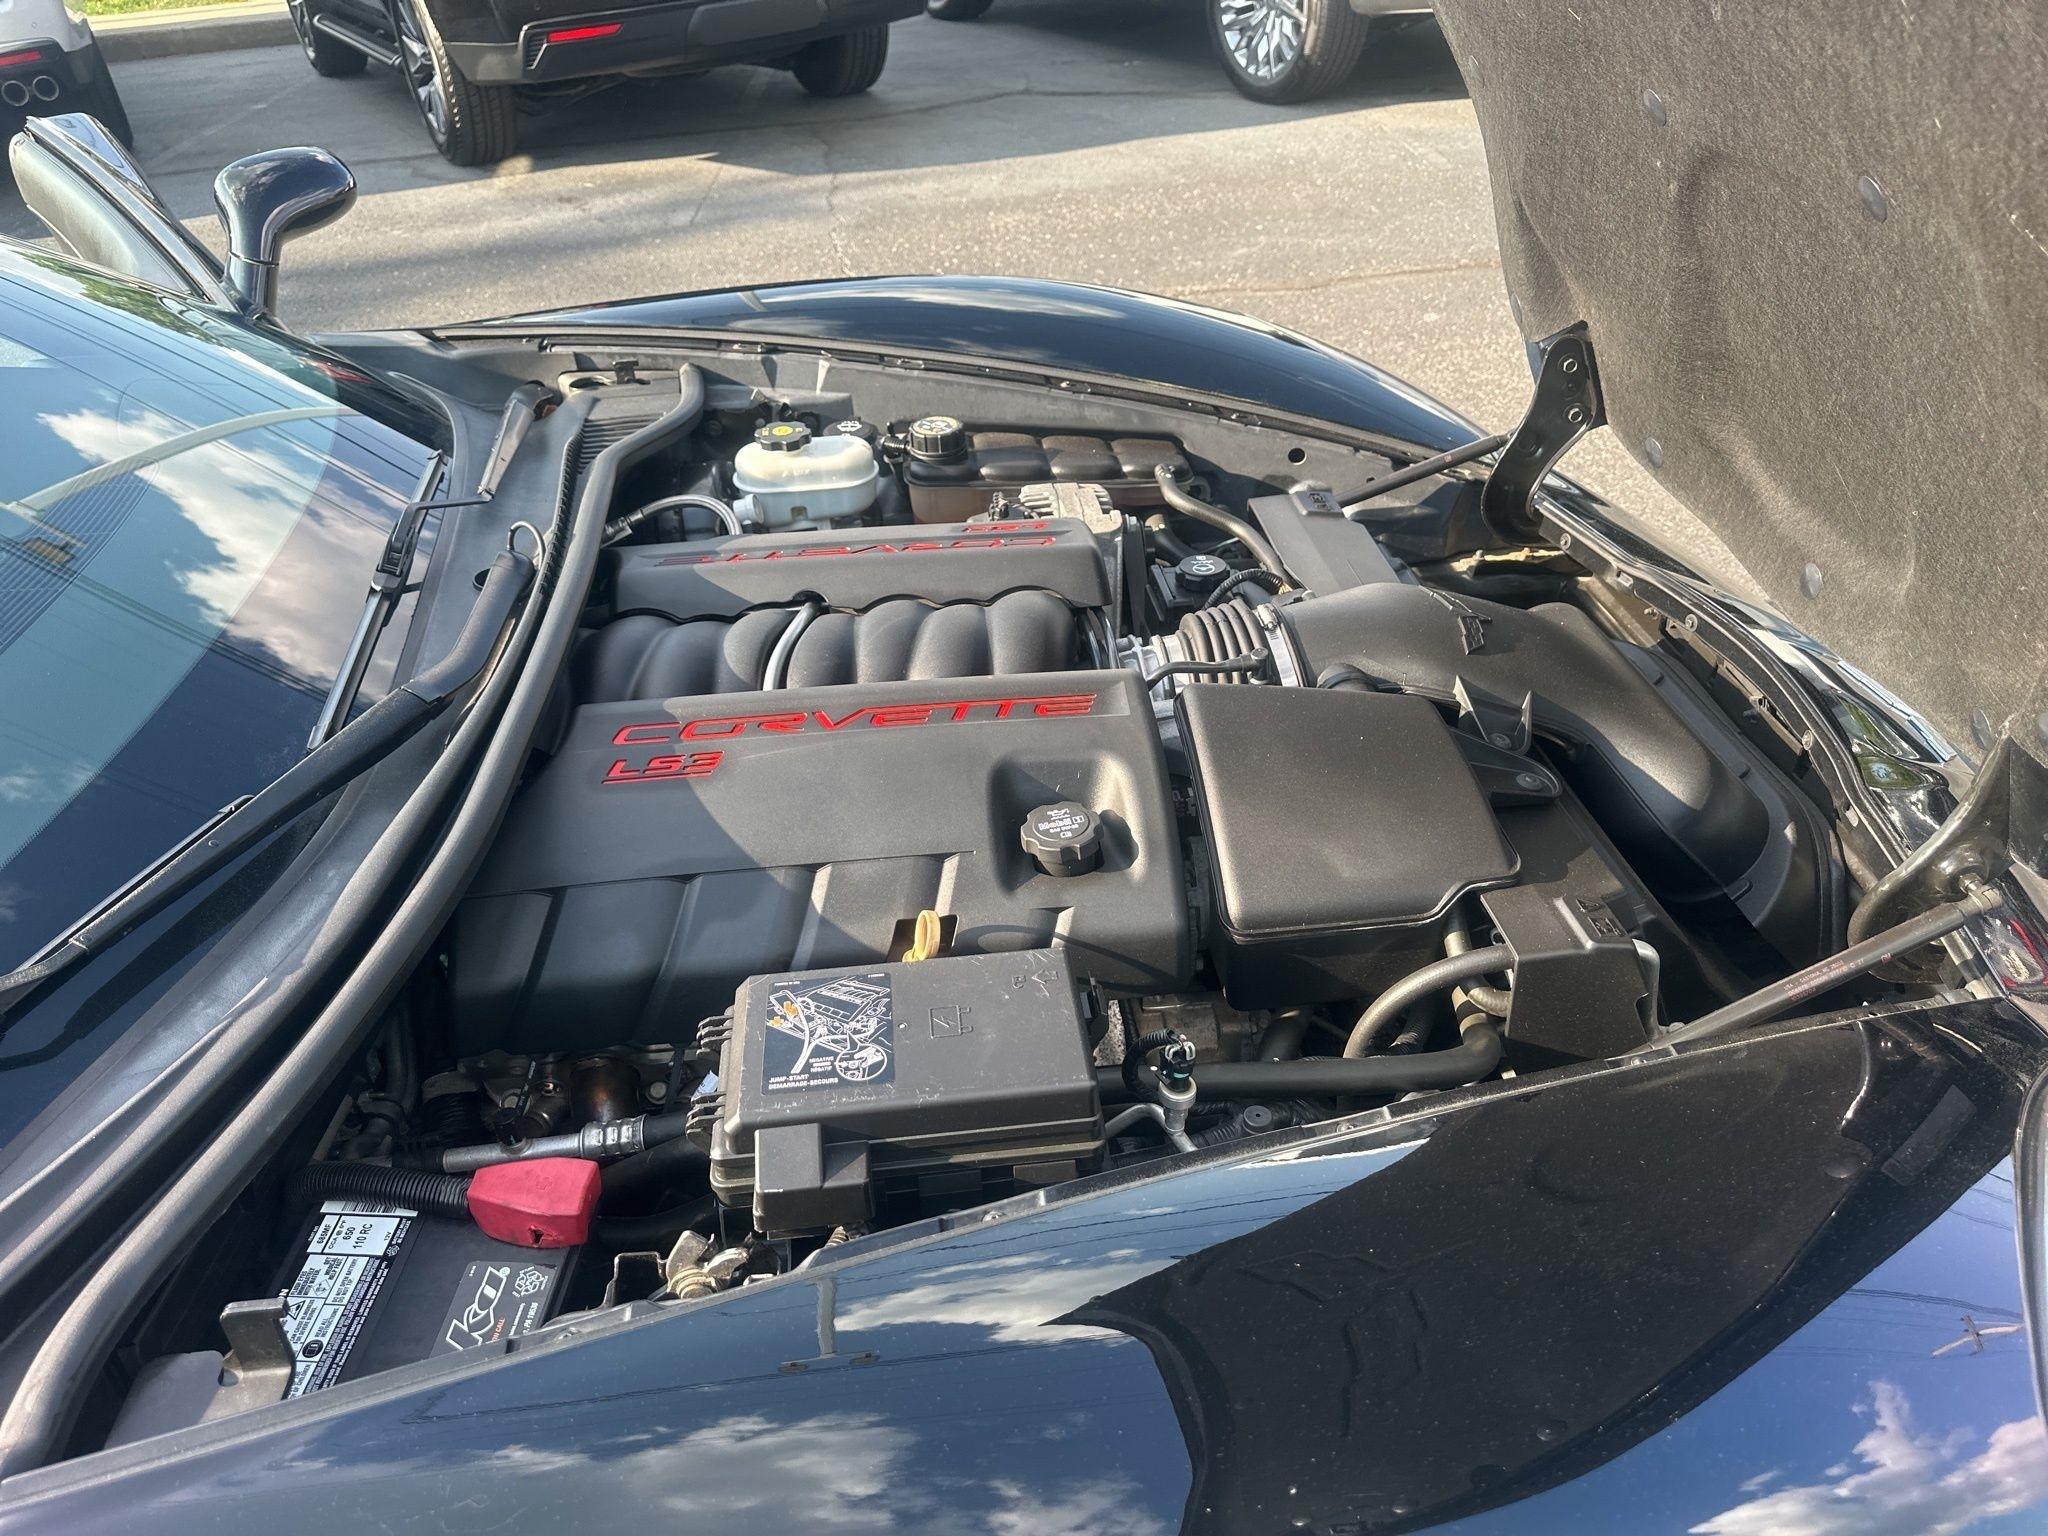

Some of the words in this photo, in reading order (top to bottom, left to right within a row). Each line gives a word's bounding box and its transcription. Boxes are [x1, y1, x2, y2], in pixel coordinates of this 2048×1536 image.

[612, 694, 1097, 746] CORVETTE
[604, 750, 724, 781] LS3
[316, 1224, 333, 1243] 685MF
[342, 1227, 356, 1240] 650
[359, 1224, 373, 1234] RC
[328, 1237, 339, 1249] CCA
[352, 1237, 367, 1248] 110
